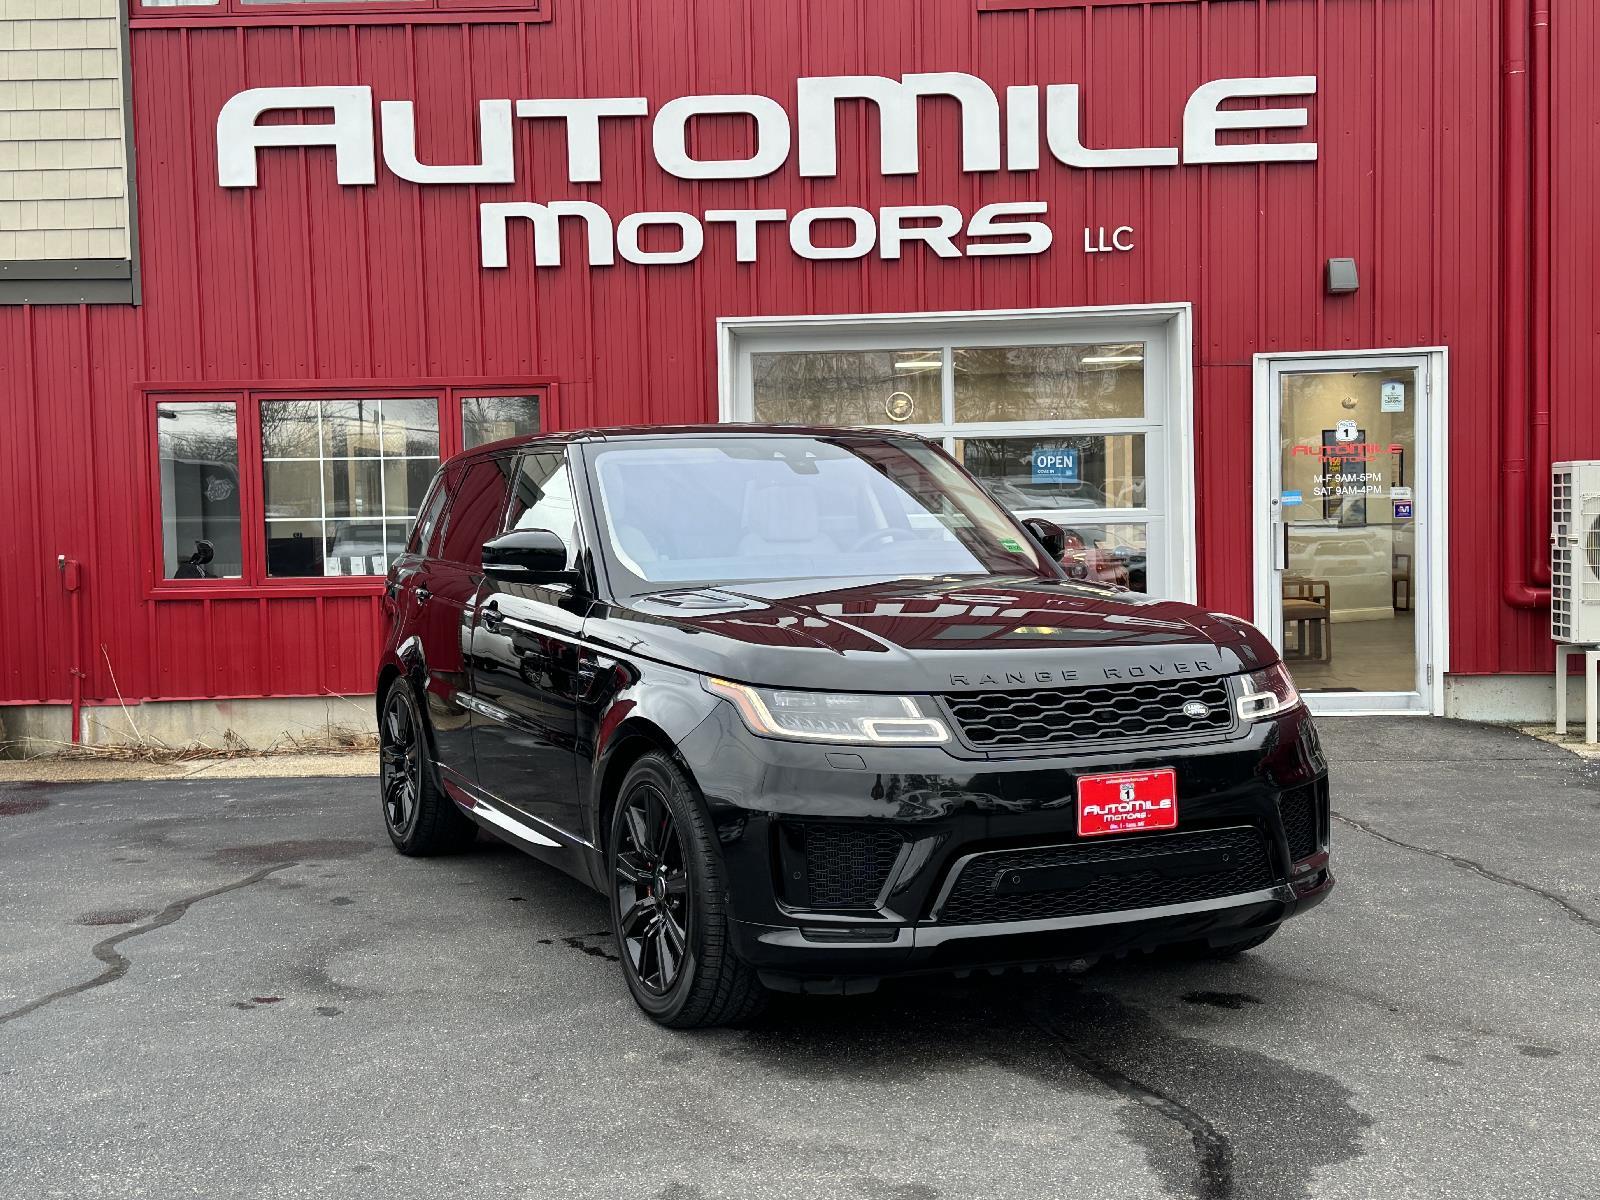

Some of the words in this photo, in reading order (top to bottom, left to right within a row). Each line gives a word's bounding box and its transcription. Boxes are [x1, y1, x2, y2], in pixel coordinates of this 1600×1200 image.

[216, 72, 1318, 188] AUTOMILE
[479, 201, 1053, 268] MOTORS
[1084, 226, 1135, 253] LLC
[1343, 428, 1349, 438] 1
[1037, 455, 1073, 468] OPEN
[1313, 474, 1332, 483] M-F
[1335, 473, 1382, 483] 9AM-5PM
[1313, 486, 1332, 496] SAT
[1335, 485, 1382, 495] 9AM-4PM
[950, 670, 1079, 686] RANGE
[1104, 660, 1213, 679] ROVER
[1125, 789, 1130, 799] 1
[1083, 798, 1172, 816] AUTOMILE
[1103, 811, 1147, 822] MOTORS
